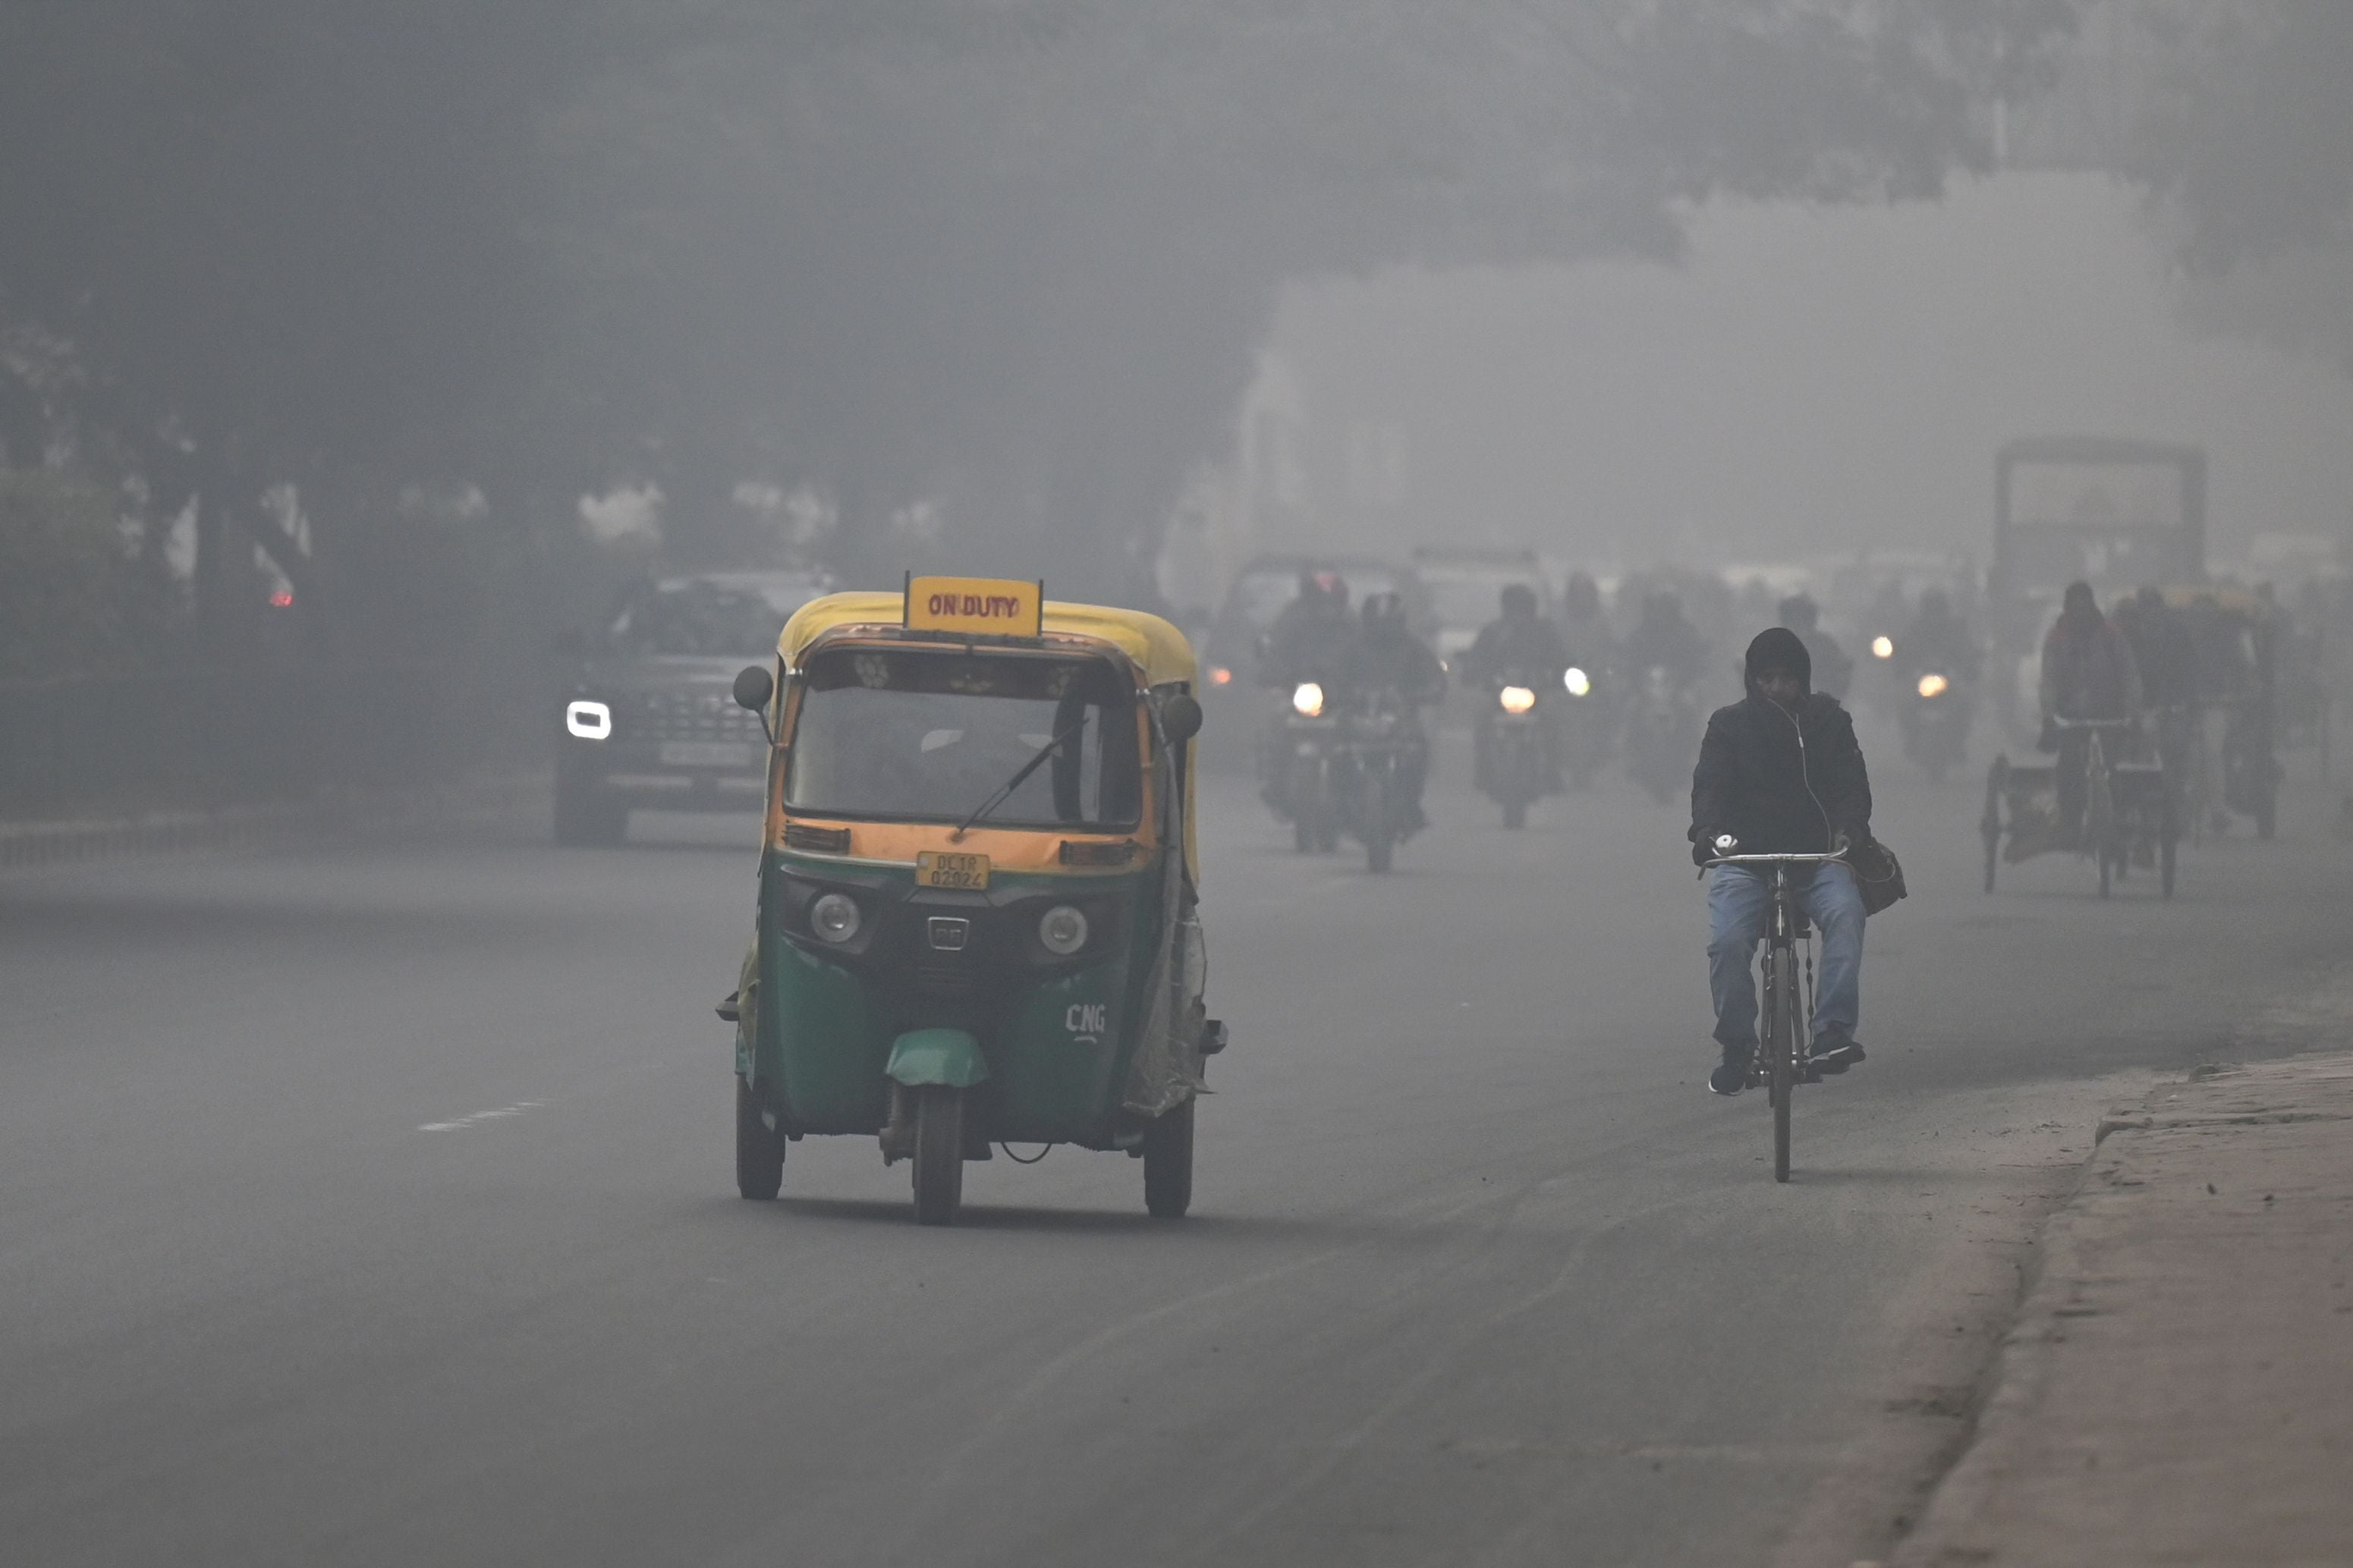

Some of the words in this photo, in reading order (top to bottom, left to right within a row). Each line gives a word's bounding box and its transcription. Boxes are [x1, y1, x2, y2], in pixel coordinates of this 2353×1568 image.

[929, 593, 956, 616] ON
[961, 595, 1018, 618] DUTY
[1065, 1004, 1106, 1032] CNG
